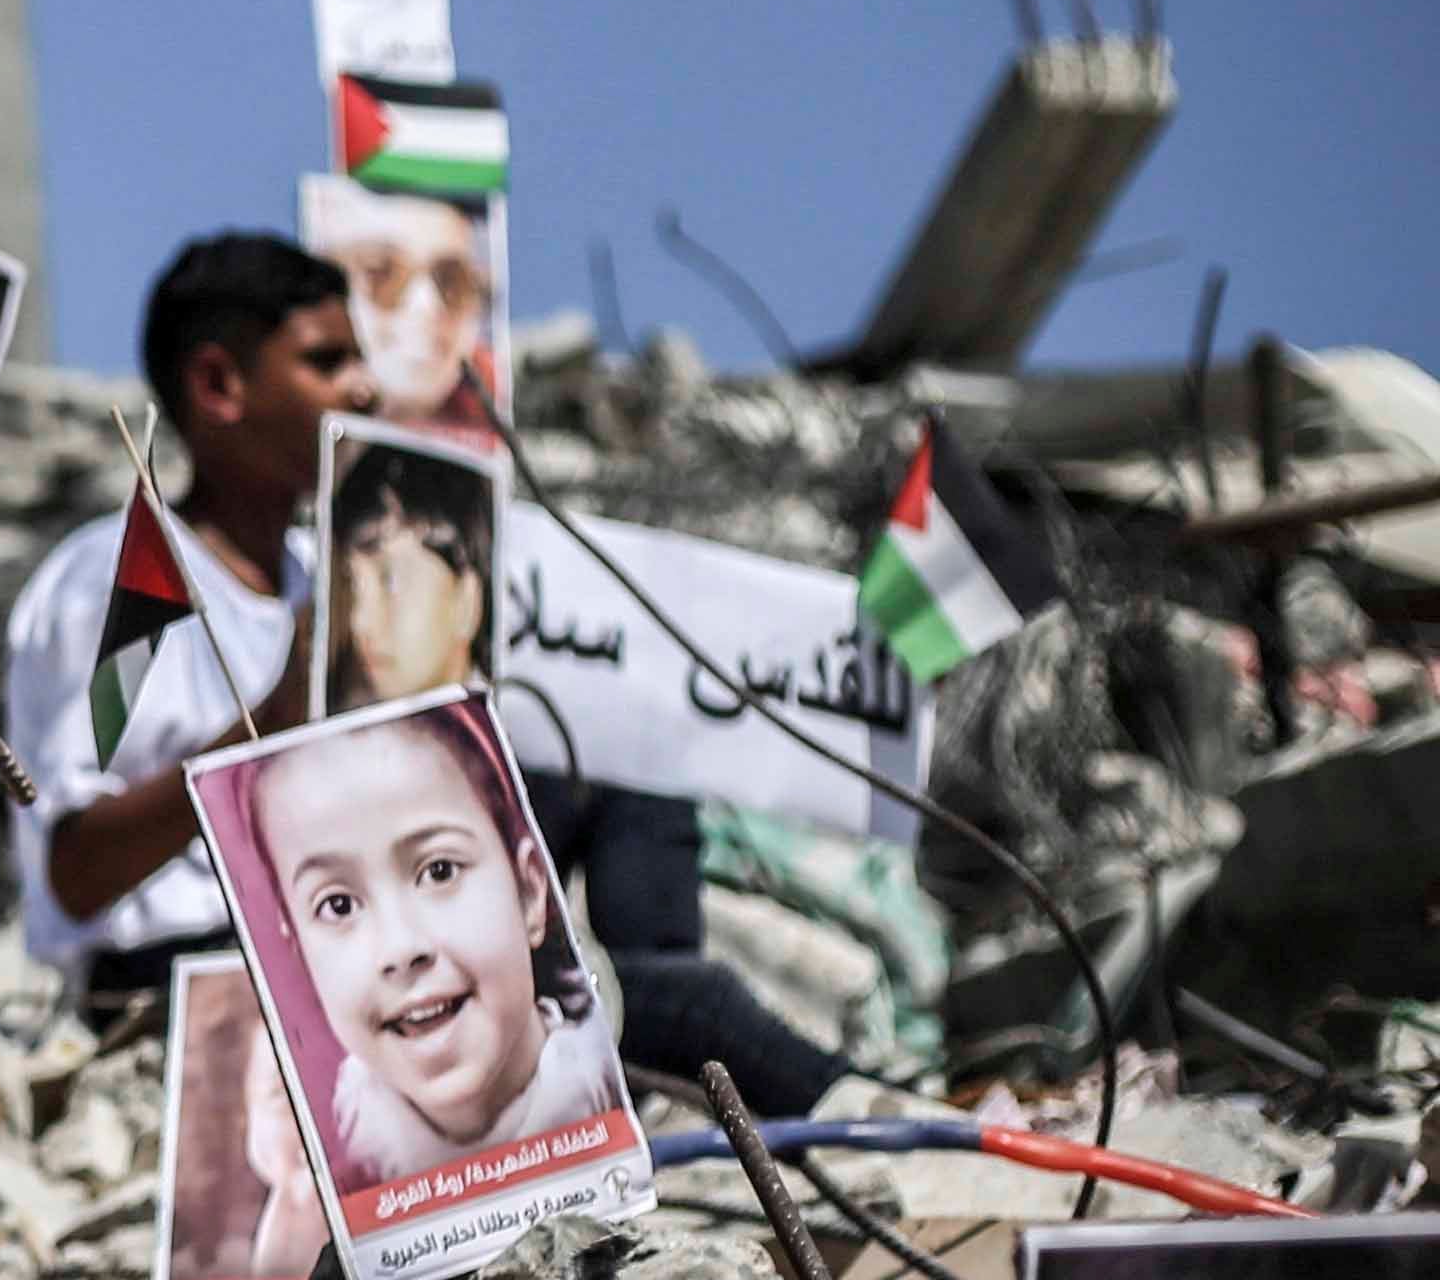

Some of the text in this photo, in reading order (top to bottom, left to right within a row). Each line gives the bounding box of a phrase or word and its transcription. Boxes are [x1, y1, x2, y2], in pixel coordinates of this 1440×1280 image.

[508, 562, 625, 666] سلا
[550, 1121, 609, 1158] الطفلة
[381, 1187, 597, 1269] جمعية لو بطلنا نحلم الخيرية
